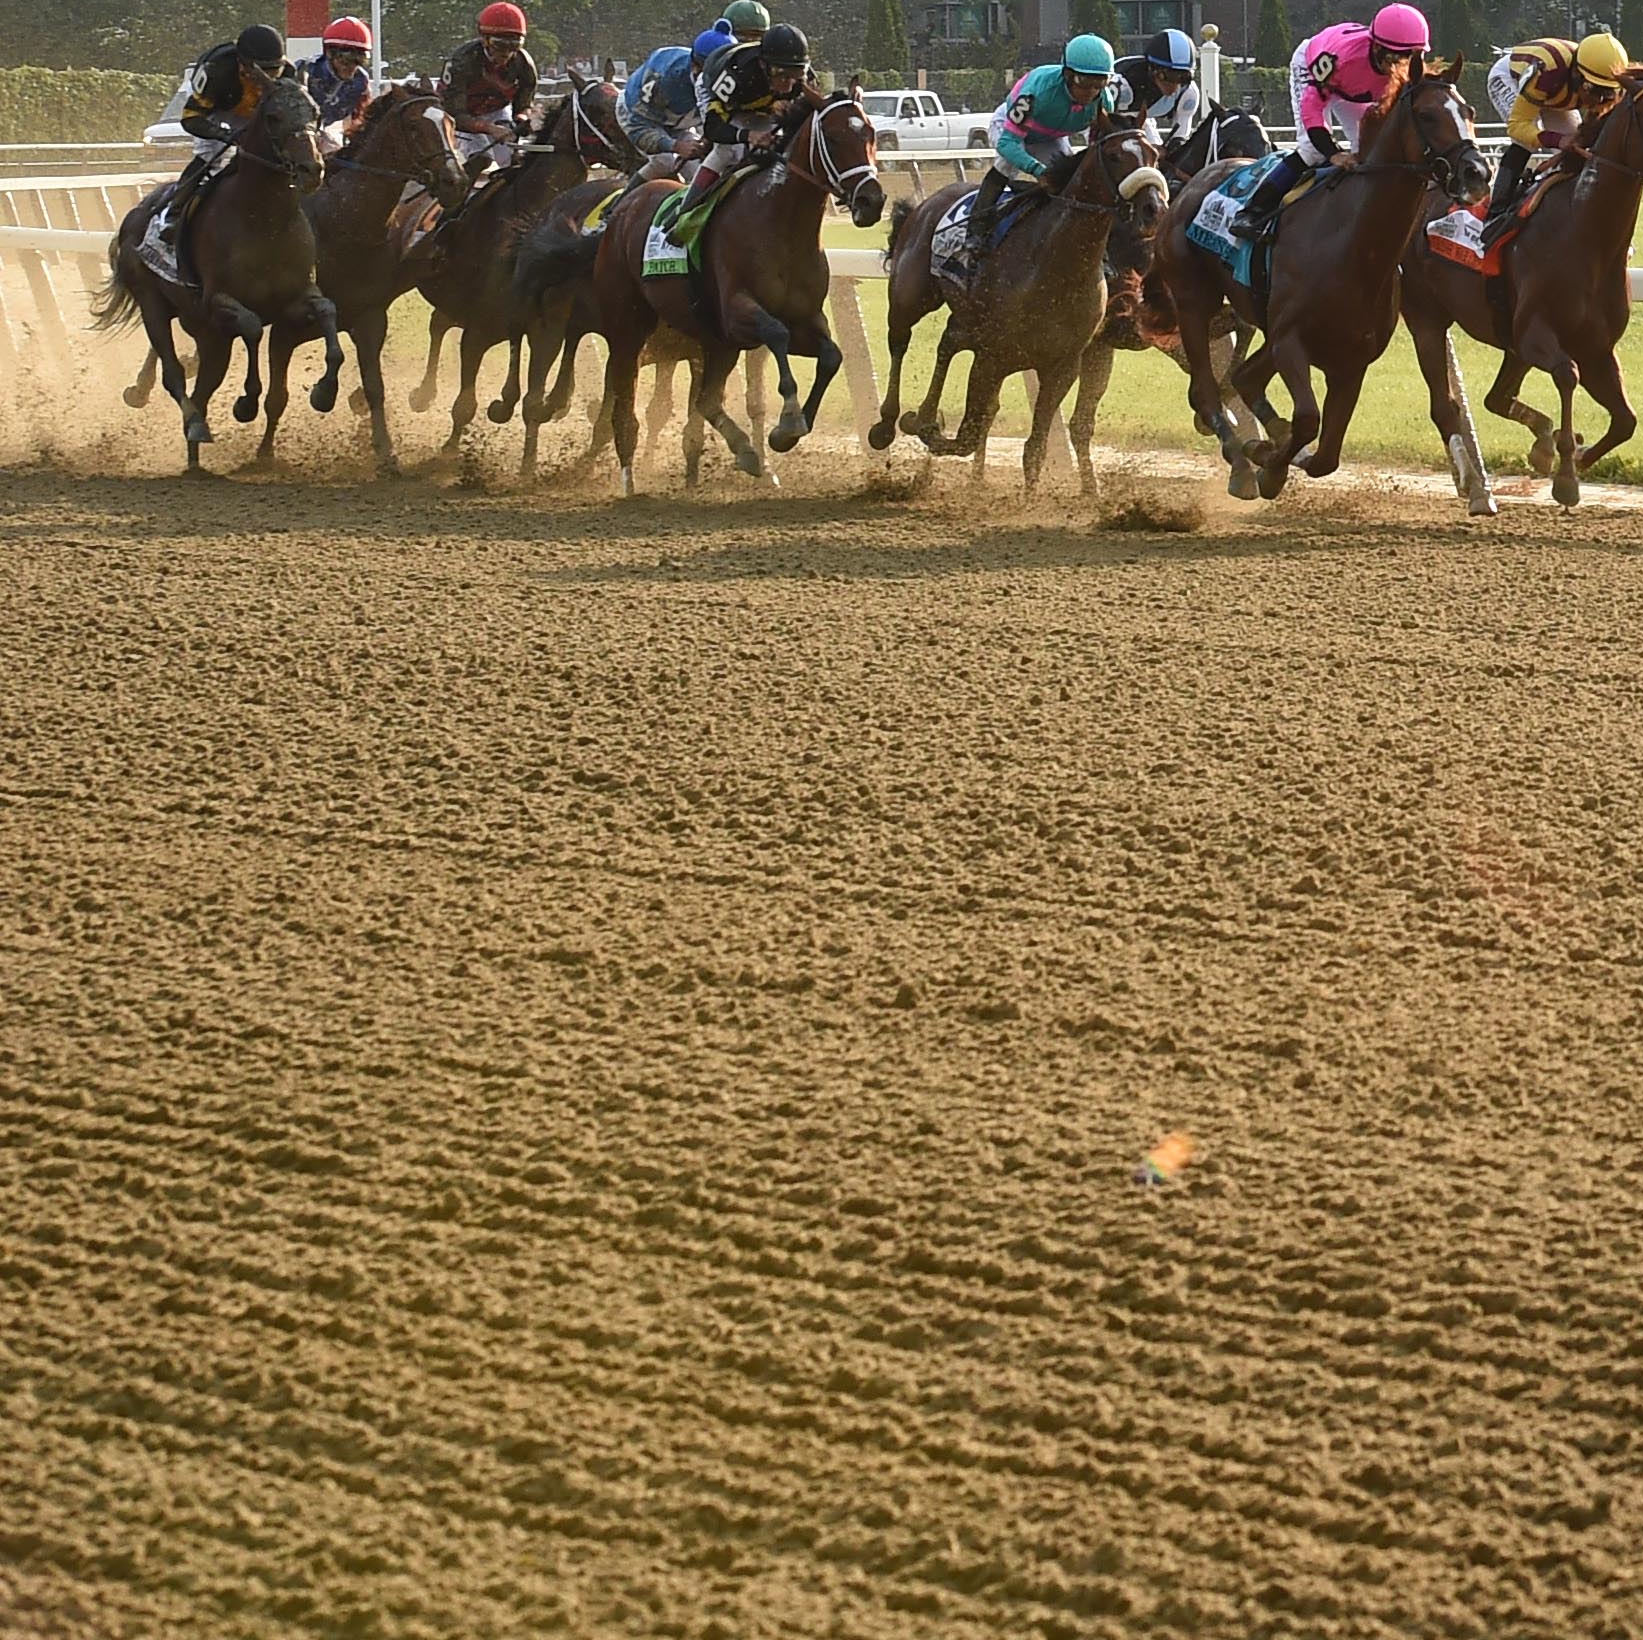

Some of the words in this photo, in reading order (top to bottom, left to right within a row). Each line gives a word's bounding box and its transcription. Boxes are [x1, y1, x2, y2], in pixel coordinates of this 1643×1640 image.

[443, 61, 452, 85] 6
[1312, 54, 1333, 82] 9
[642, 80, 656, 103] 4
[711, 70, 736, 103] 12
[1009, 98, 1030, 125] 3
